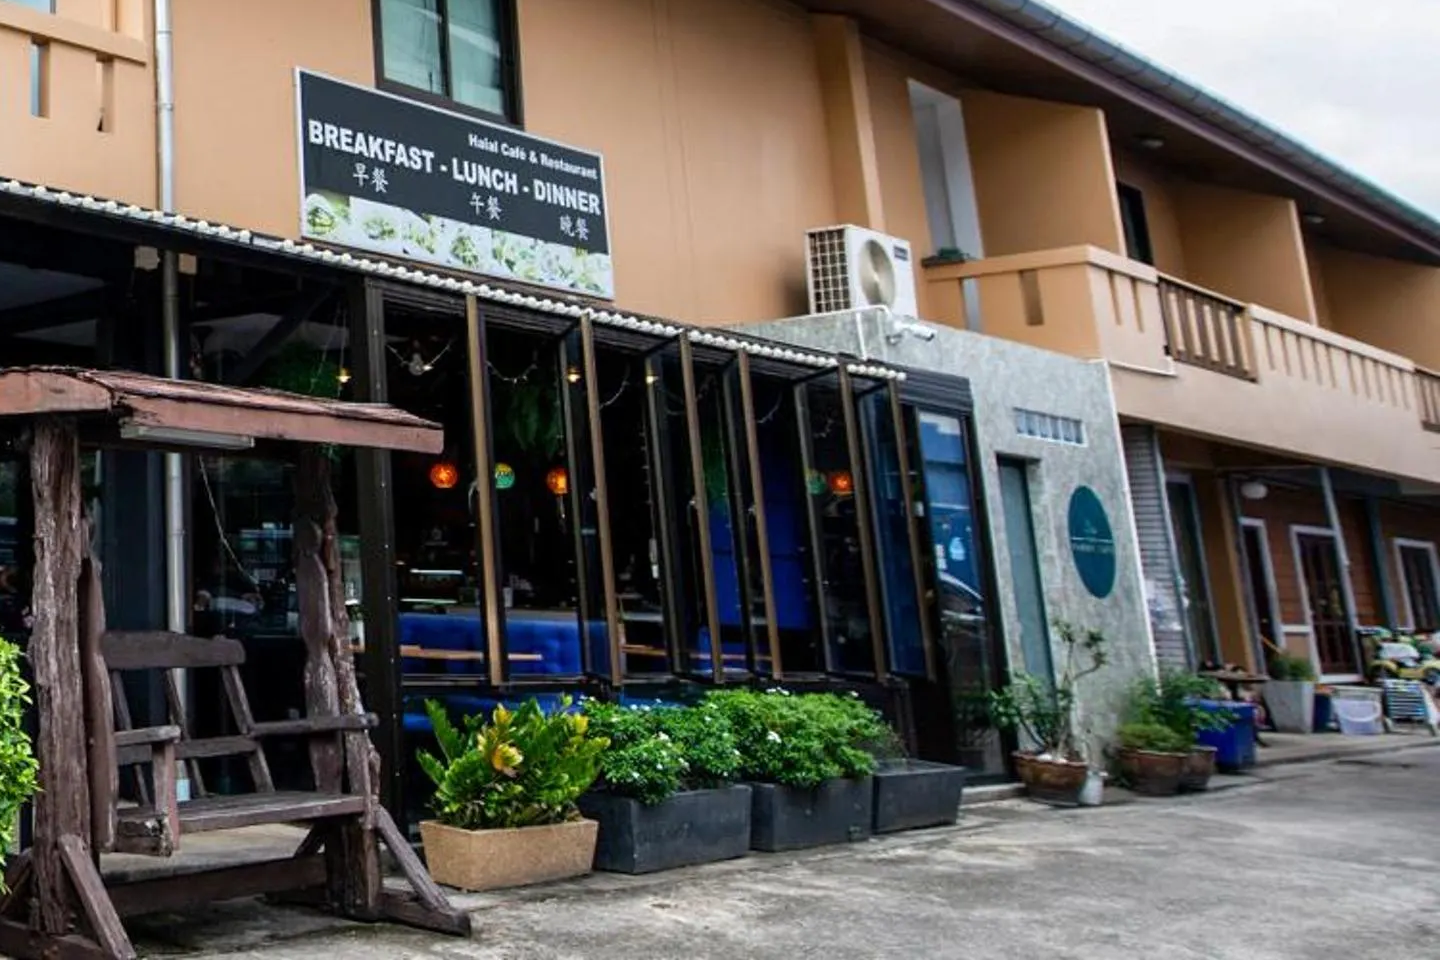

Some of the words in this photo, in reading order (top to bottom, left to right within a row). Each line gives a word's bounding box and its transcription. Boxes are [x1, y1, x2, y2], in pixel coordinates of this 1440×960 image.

[309, 119, 435, 173] BREAKFAST
[452, 157, 518, 195] LUNCH
[533, 178, 601, 215] DINNER
[468, 133, 498, 154] Halal
[528, 151, 538, 164] &
[540, 153, 598, 180] Restaurant
[352, 162, 389, 193] 早餐
[470, 192, 502, 221] 午餐
